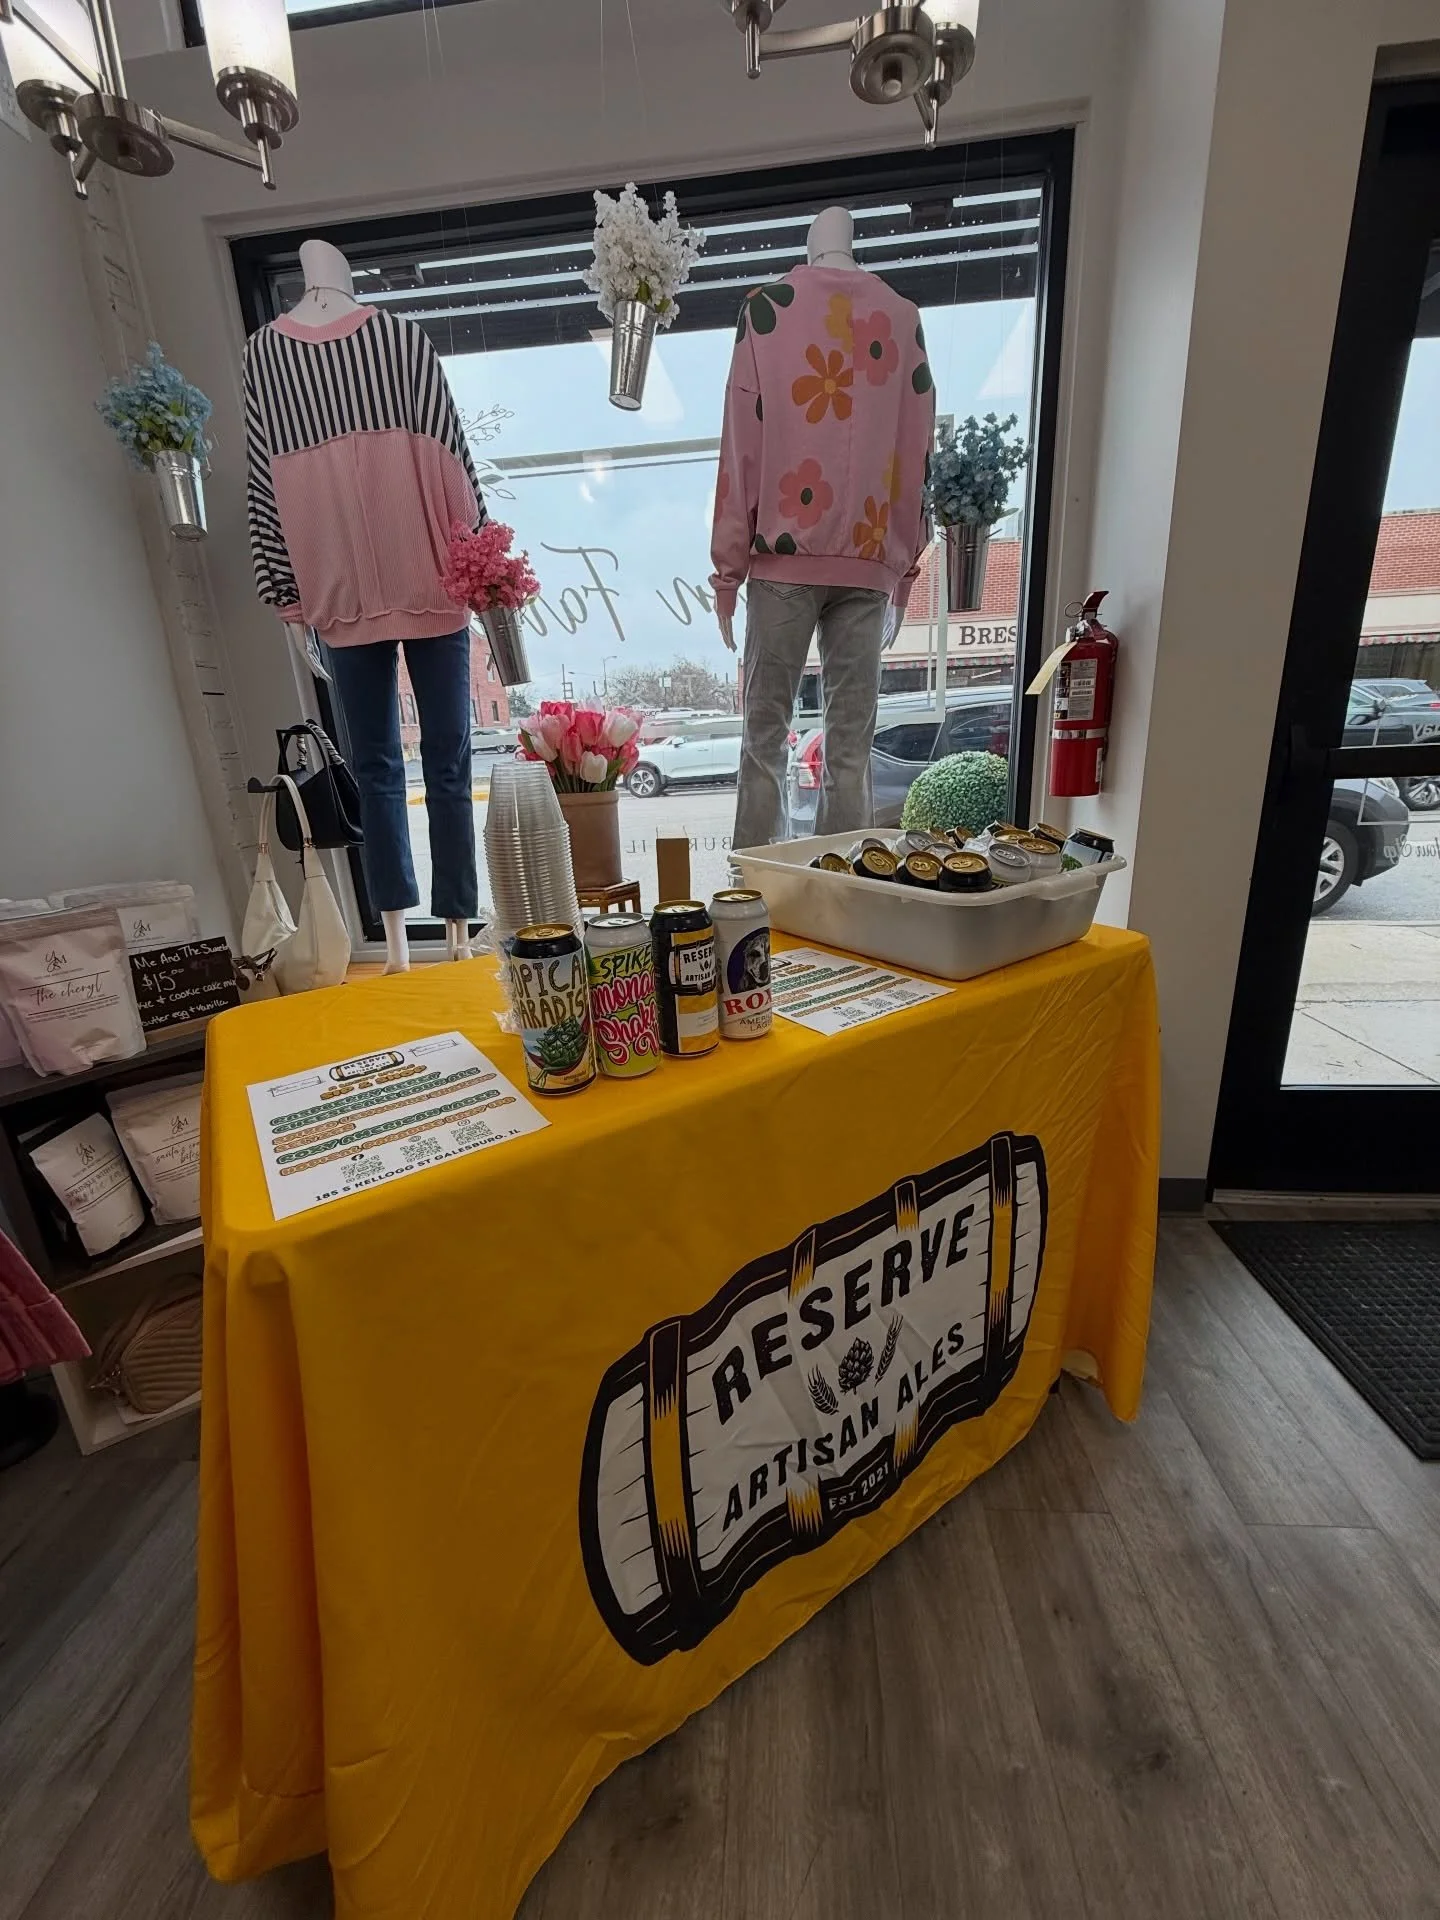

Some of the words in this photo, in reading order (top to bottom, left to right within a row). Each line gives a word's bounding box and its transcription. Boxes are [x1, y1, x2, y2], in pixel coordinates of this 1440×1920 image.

[134, 957, 157, 970] Me
[160, 953, 181, 965] And
[178, 945, 201, 958] The
[600, 944, 652, 979] SPIKE
[683, 947, 713, 964] RESER
[169, 988, 201, 1002] cookie
[202, 983, 223, 993] cake
[723, 988, 772, 1016] ROX
[172, 1010, 191, 1020] egg
[516, 987, 587, 1029] ARADIS
[739, 1013, 772, 1025] AMERI
[750, 1022, 772, 1032] LAG
[275, 1137, 341, 1166] ROXY
[353, 1162, 415, 1190] KELLOGG
[415, 1157, 432, 1168] ST
[507, 1127, 521, 1135] IL
[711, 1202, 976, 1426] RESERVE
[721, 1399, 880, 1531] ARTISAN
[896, 1321, 965, 1413] ALES
[828, 1490, 856, 1512] EST
[861, 1466, 891, 1496] 2021
